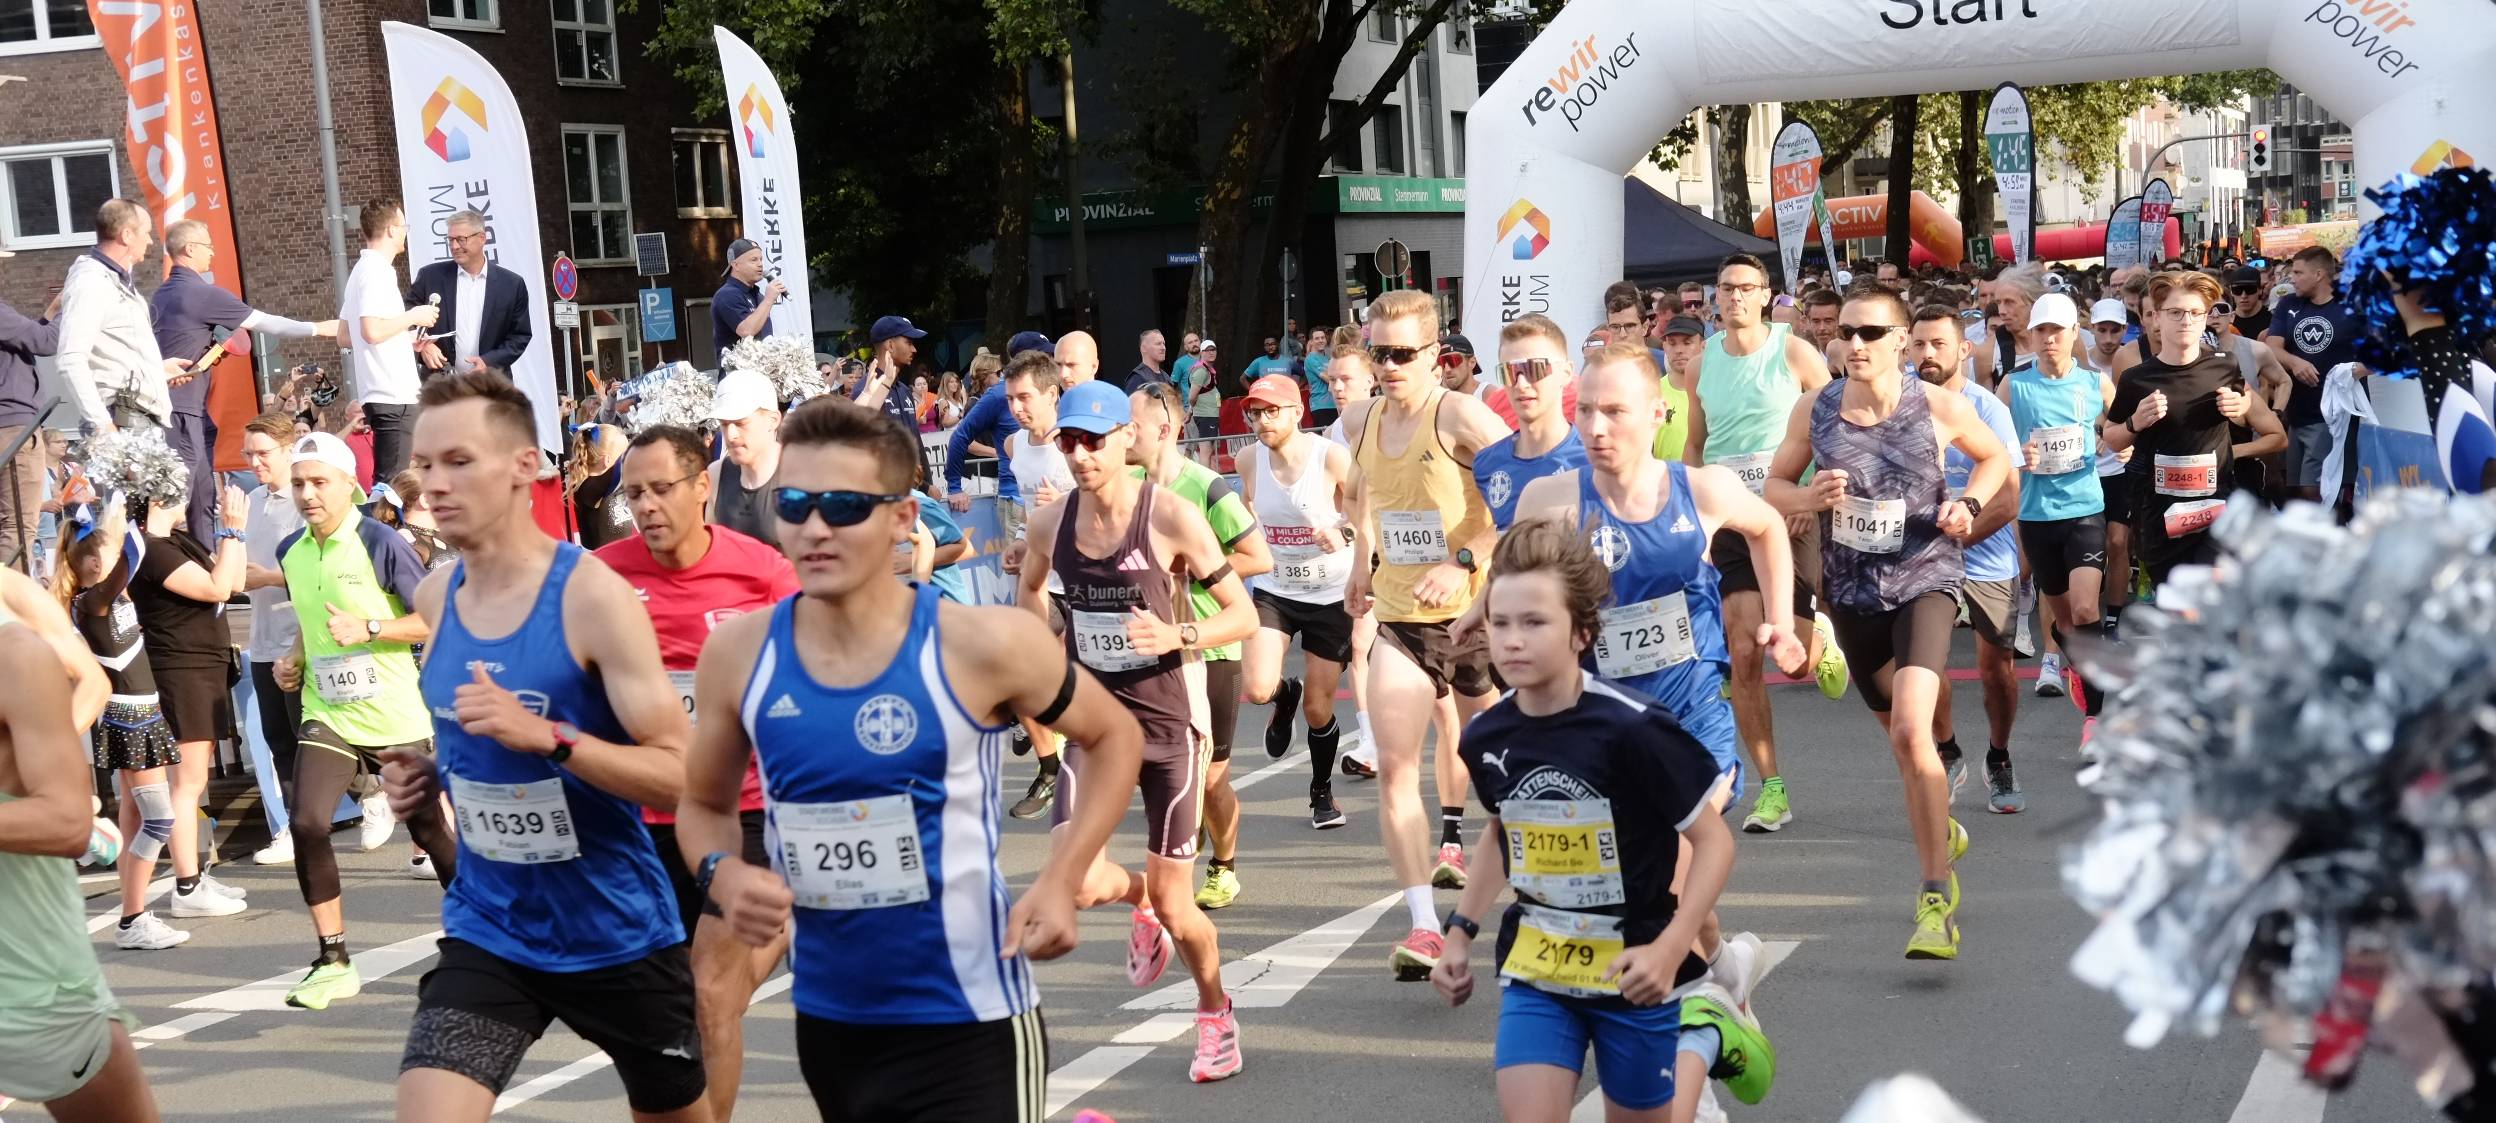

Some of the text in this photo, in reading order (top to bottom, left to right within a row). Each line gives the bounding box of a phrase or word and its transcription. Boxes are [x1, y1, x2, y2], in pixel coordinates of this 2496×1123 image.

[2304, 0, 2419, 78] power
[1521, 33, 1599, 127] rewir
[1560, 31, 1640, 132] power
[1169, 253, 1198, 266] Marienplatz
[646, 293, 660, 315] P
[2042, 438, 2075, 453] 1497
[2167, 472, 2203, 482] 2248-1
[1846, 514, 1888, 535] 1041
[2180, 510, 2213, 527] 2248
[1276, 527, 1312, 536] MILERS
[1393, 529, 1432, 546] 1460
[1285, 566, 1311, 577] 385
[1087, 582, 1142, 600] bunert
[1620, 624, 1666, 652] 723
[1634, 650, 1660, 662] Oliver
[327, 671, 358, 688] 140
[1515, 771, 1595, 800] ATTENSCHEI
[476, 810, 545, 836] 1639
[1527, 831, 1590, 852] 2179-1
[814, 839, 878, 871] 296
[835, 880, 864, 890] Elias
[1577, 890, 1622, 905] 2179-1
[1536, 938, 1594, 966] 2179
